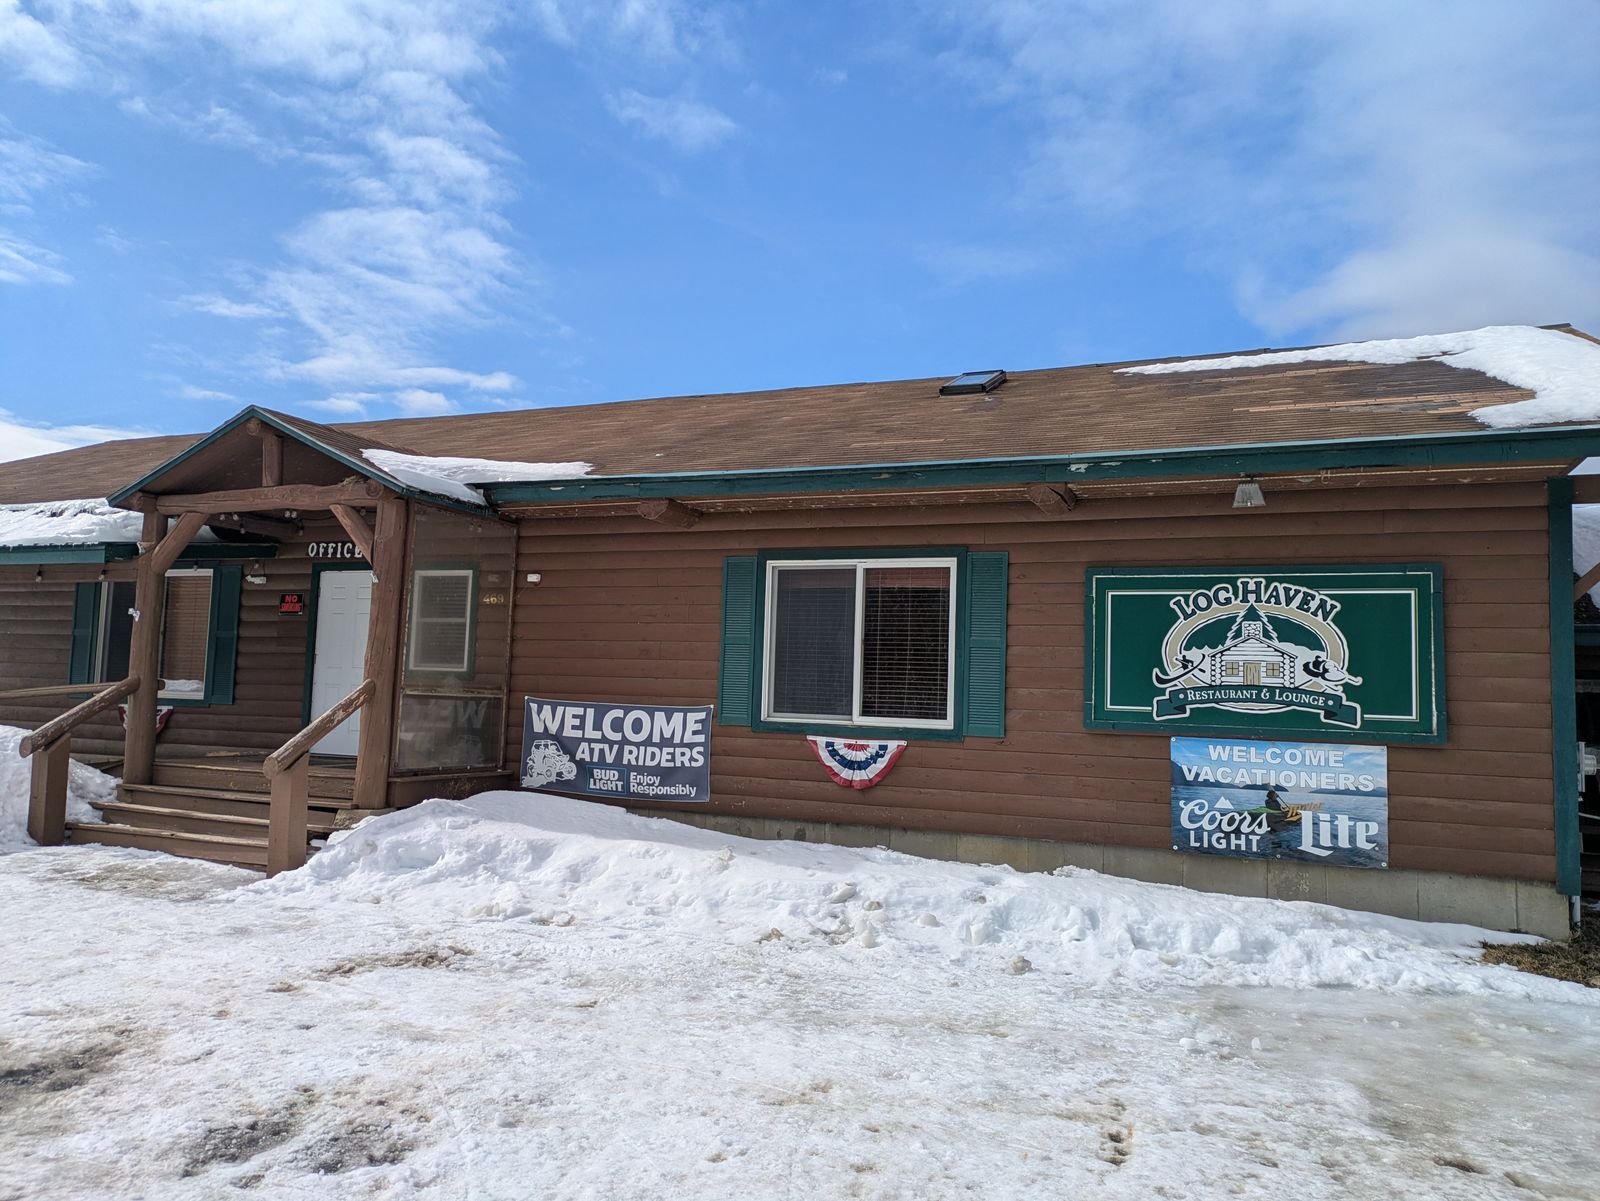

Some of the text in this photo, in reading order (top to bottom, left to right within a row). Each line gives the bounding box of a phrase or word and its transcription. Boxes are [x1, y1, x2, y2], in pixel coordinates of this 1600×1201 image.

[308, 542, 363, 558] OFFICE
[285, 595, 298, 603] NO
[1171, 579, 1339, 623] LOG HAVEN
[1187, 688, 1326, 706] RESTAURANT & LOUNGE
[528, 702, 707, 744] WELCOME
[575, 742, 705, 768] ATV RIDERS
[1208, 744, 1345, 768] WELCOME
[589, 778, 624, 791] LIGHT
[593, 768, 619, 781] BUD
[629, 772, 661, 786] Enjoy
[1181, 764, 1375, 792] VACATIONERS
[629, 783, 697, 797] Responsibly
[1179, 799, 1271, 835] Coors
[1189, 830, 1261, 852] LIGHT
[1297, 809, 1380, 857] Lite
